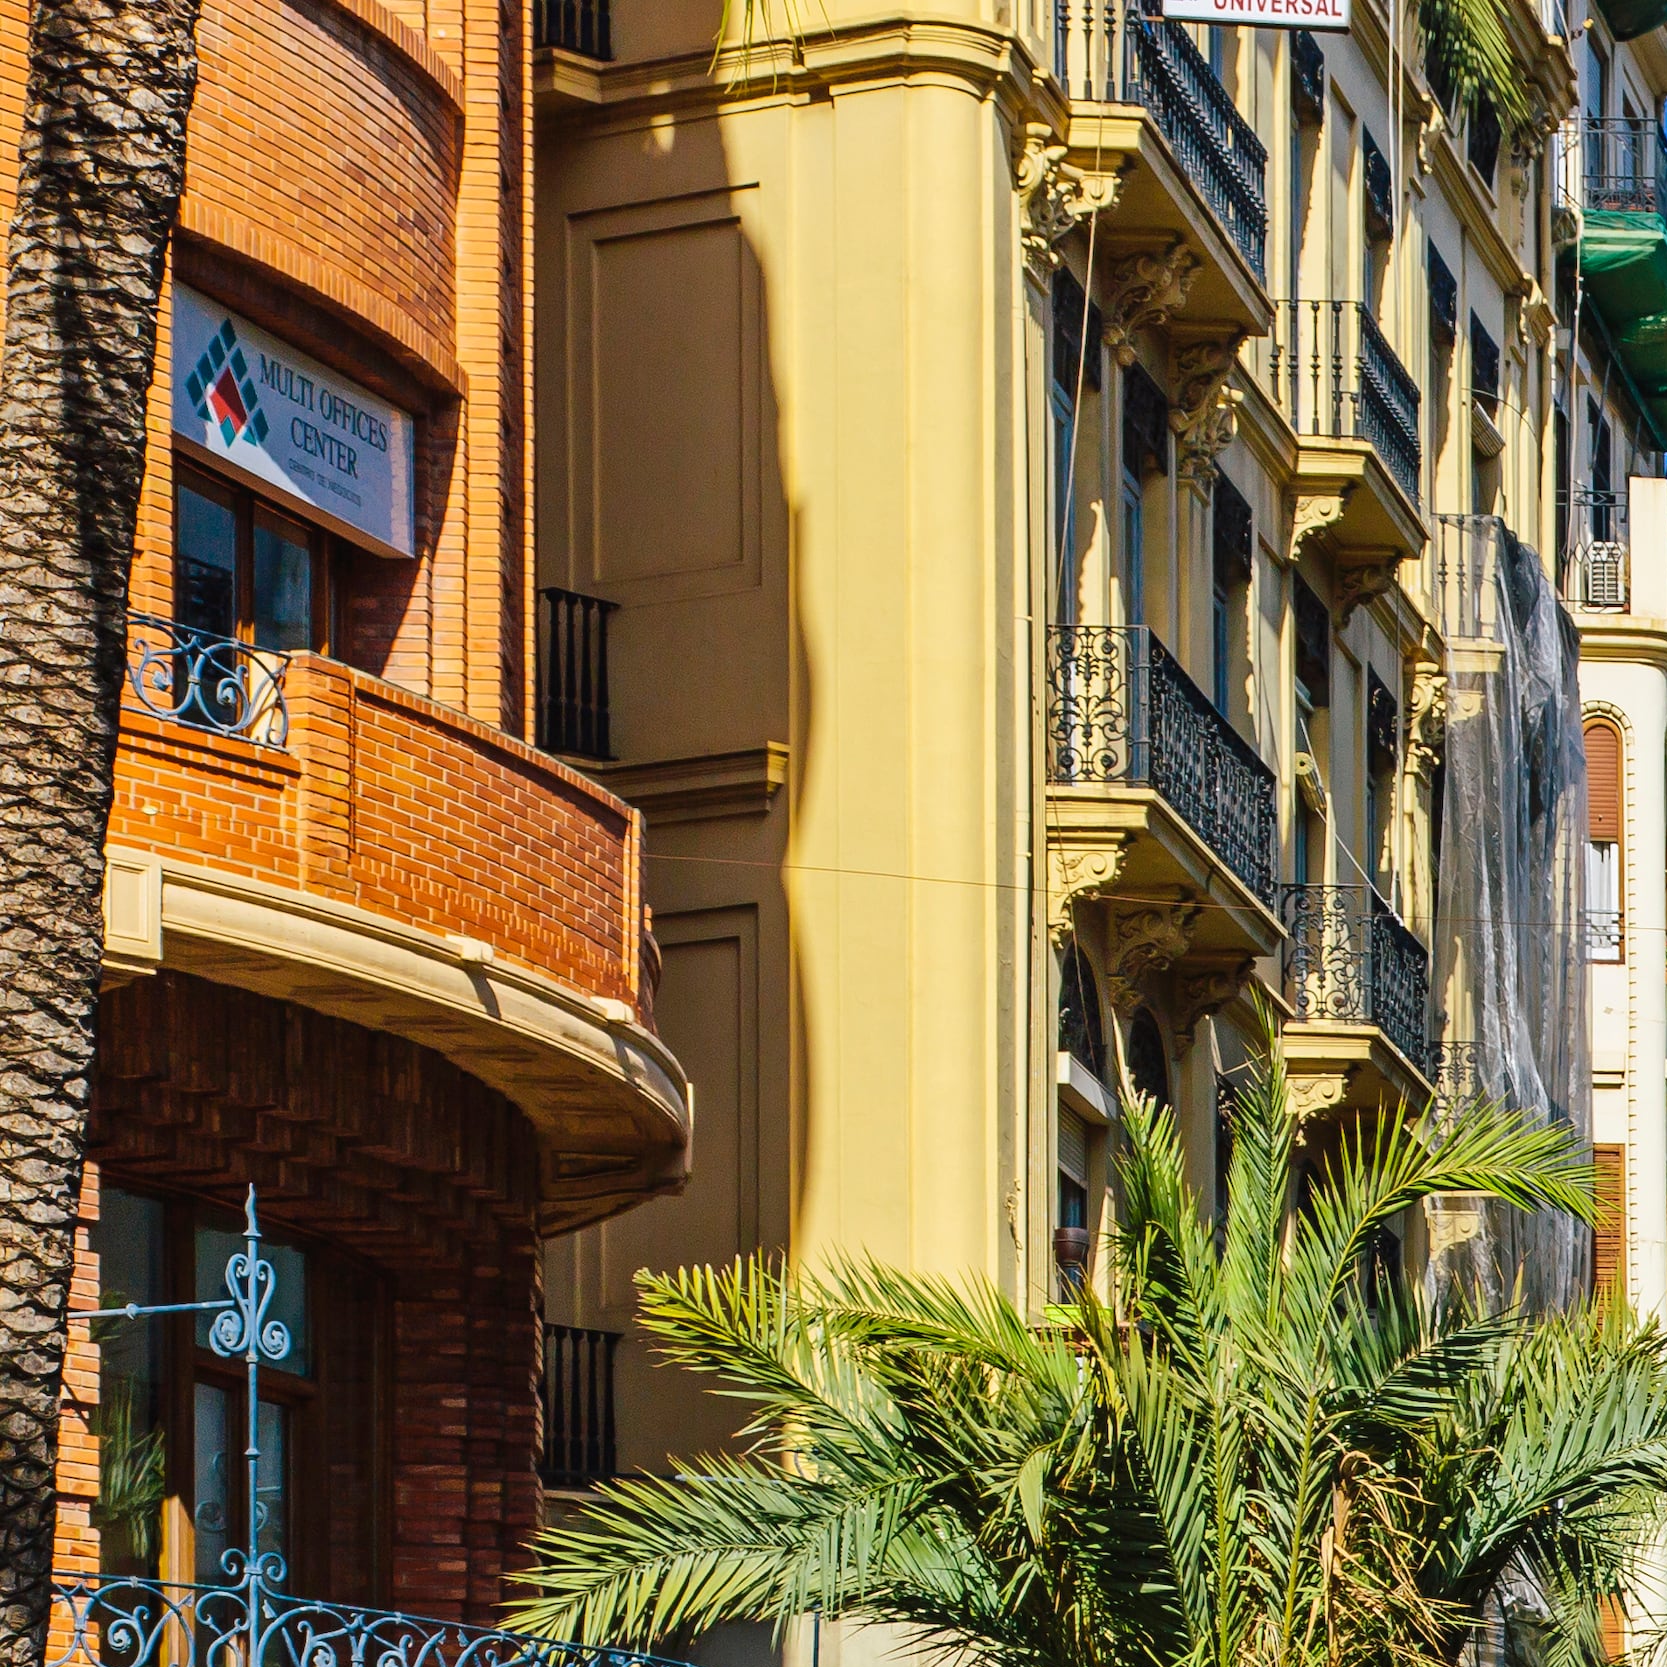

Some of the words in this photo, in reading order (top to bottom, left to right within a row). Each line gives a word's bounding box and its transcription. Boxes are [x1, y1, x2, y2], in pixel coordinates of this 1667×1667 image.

[1213, 0, 1342, 17] UNIVERSAL
[260, 353, 314, 413] MULTI
[319, 387, 388, 453] OFFICES
[291, 416, 359, 480] CENTER
